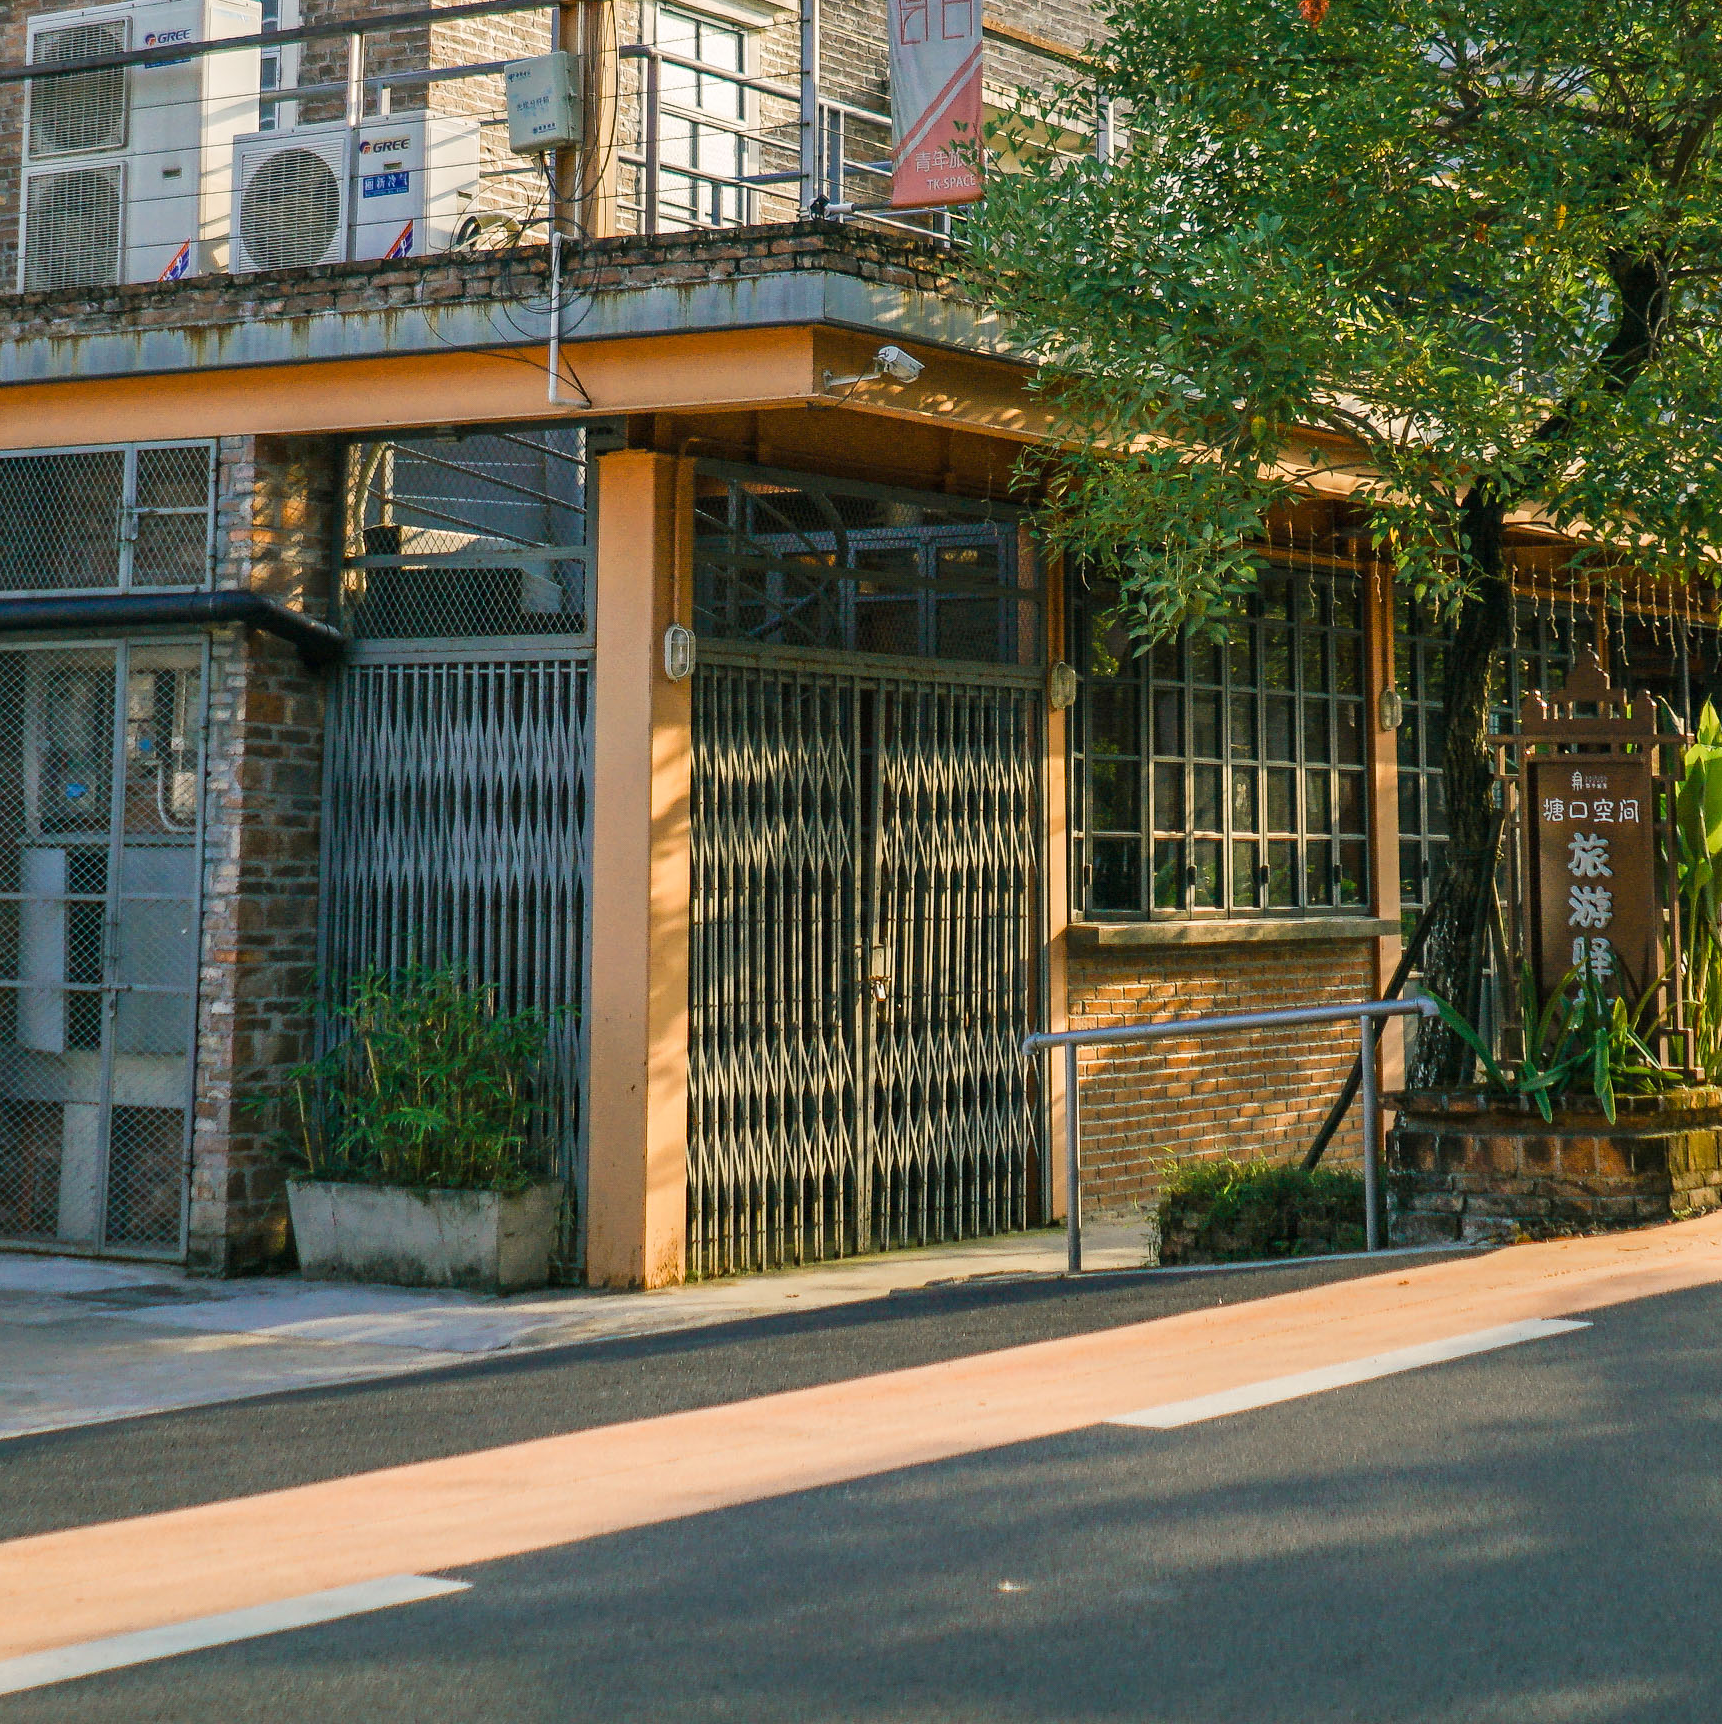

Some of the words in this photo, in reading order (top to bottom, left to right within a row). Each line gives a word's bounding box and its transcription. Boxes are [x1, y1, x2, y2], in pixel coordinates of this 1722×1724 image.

[158, 28, 192, 44] GREE
[373, 138, 411, 154] GREE
[1542, 797, 1641, 825] 塘口空间
